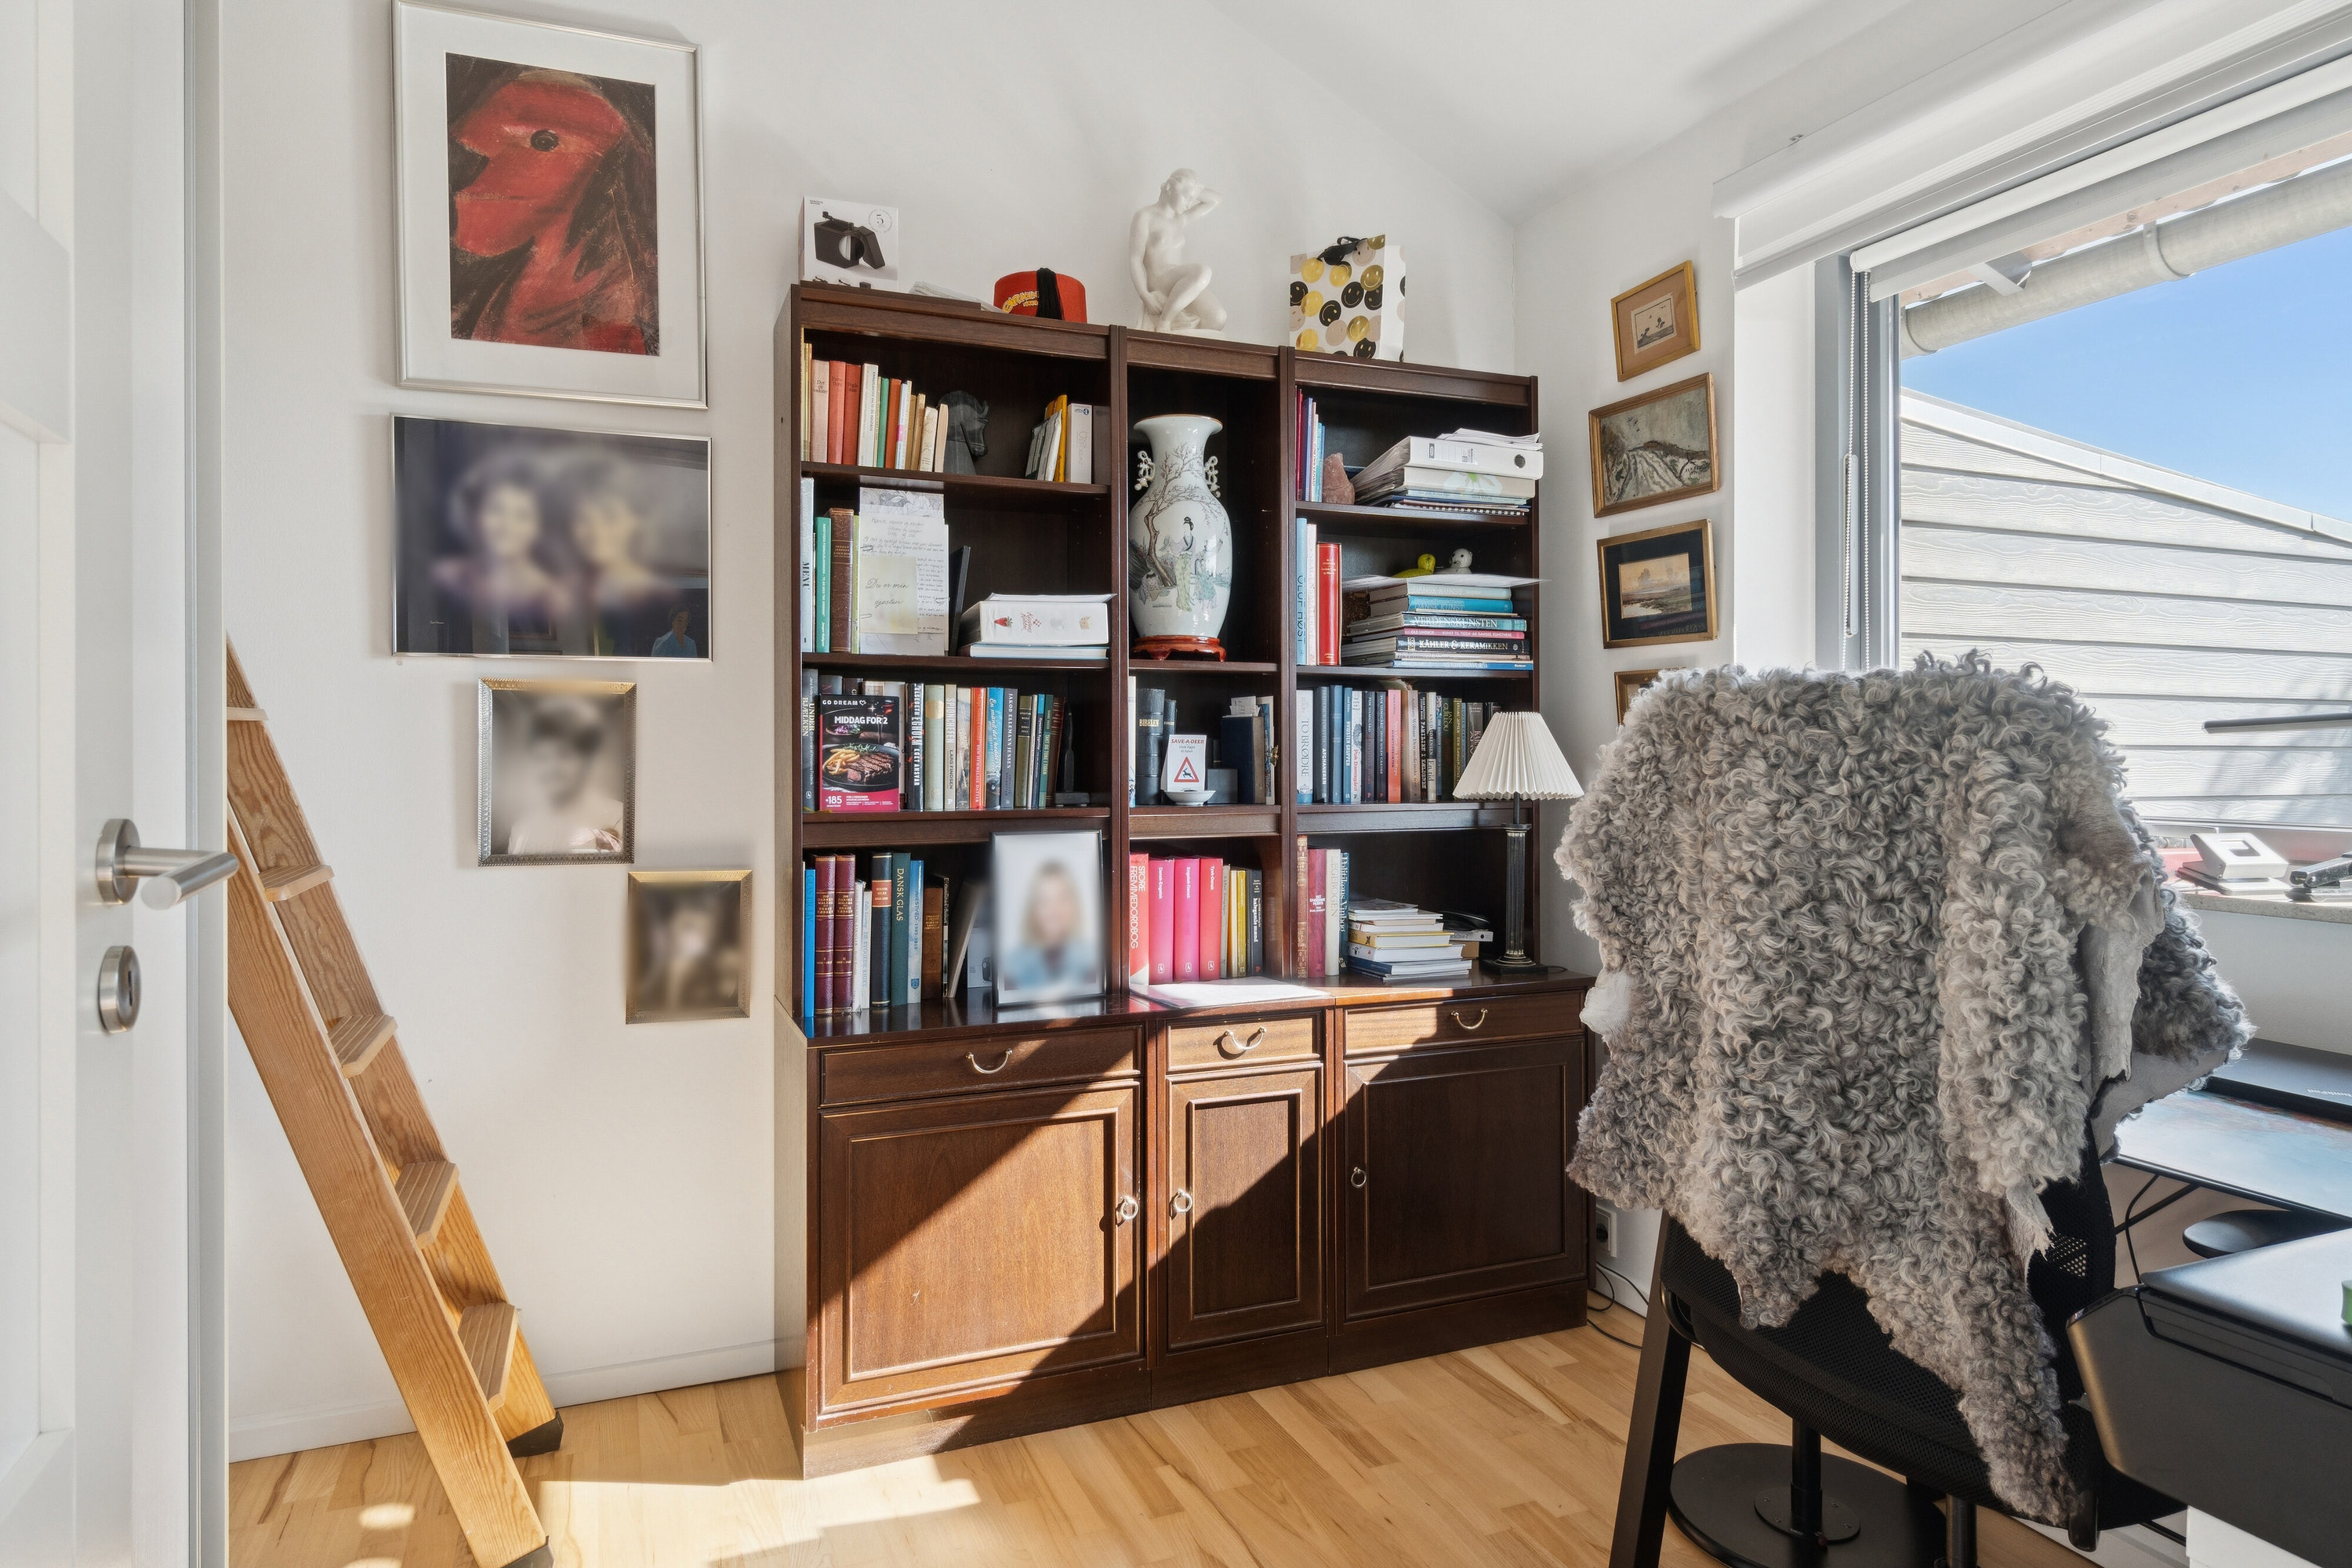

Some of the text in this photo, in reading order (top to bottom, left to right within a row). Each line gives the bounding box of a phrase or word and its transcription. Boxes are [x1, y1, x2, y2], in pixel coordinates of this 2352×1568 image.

[1414, 616, 1497, 628] VERDENSKUNSTEN
[1450, 641, 1458, 650] &
[1460, 642, 1508, 651] KERAMIKKEN
[989, 698, 996, 707] En
[834, 716, 866, 724] MIDDAG
[946, 698, 956, 743] SPIONCHEFEN
[1301, 718, 1308, 733] TO
[912, 717, 923, 746] EGHOLM
[1301, 735, 1309, 777] BRØDRE
[1428, 760, 1434, 771] En
[1339, 856, 1348, 932] Politikens Vinbog
[1130, 866, 1138, 949] FREMMEDORDBOG
